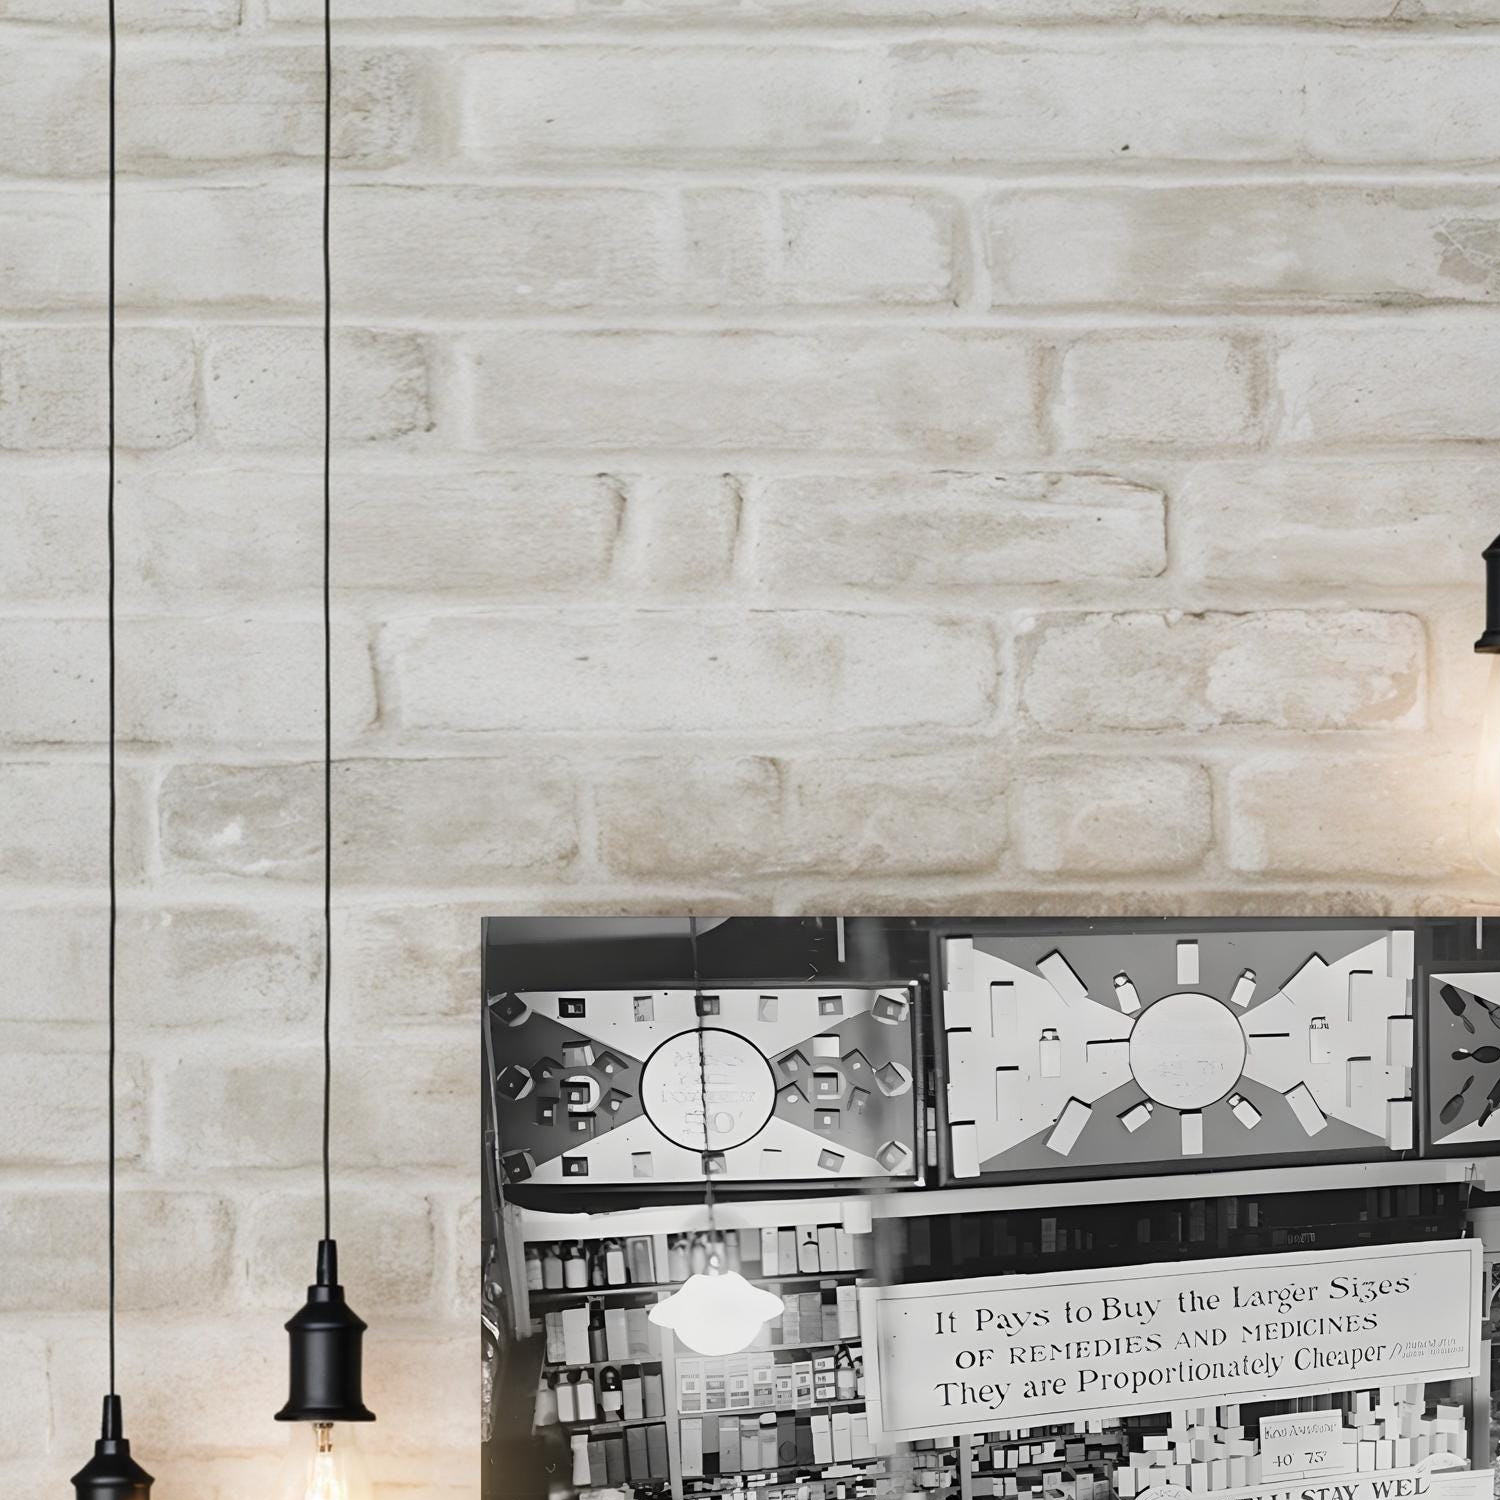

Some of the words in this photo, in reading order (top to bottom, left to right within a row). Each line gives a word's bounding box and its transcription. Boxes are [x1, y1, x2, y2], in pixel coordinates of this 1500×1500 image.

[934, 1310, 958, 1335] It
[975, 1308, 1051, 1337] Pays
[1065, 1300, 1093, 1324] to
[1101, 1296, 1162, 1326] Buy
[1177, 1290, 1220, 1313] the
[1232, 1283, 1319, 1314] Larger
[1328, 1275, 1412, 1304] Sizes
[954, 1349, 995, 1370] OF
[1009, 1333, 1163, 1365] REMEDIES
[1173, 1328, 1228, 1351] AND
[1241, 1312, 1379, 1344] MEDICINES
[933, 1382, 1012, 1410] They
[1023, 1377, 1067, 1399] are
[1076, 1351, 1285, 1394] Proportionately
[1293, 1343, 1387, 1372] Cheaper
